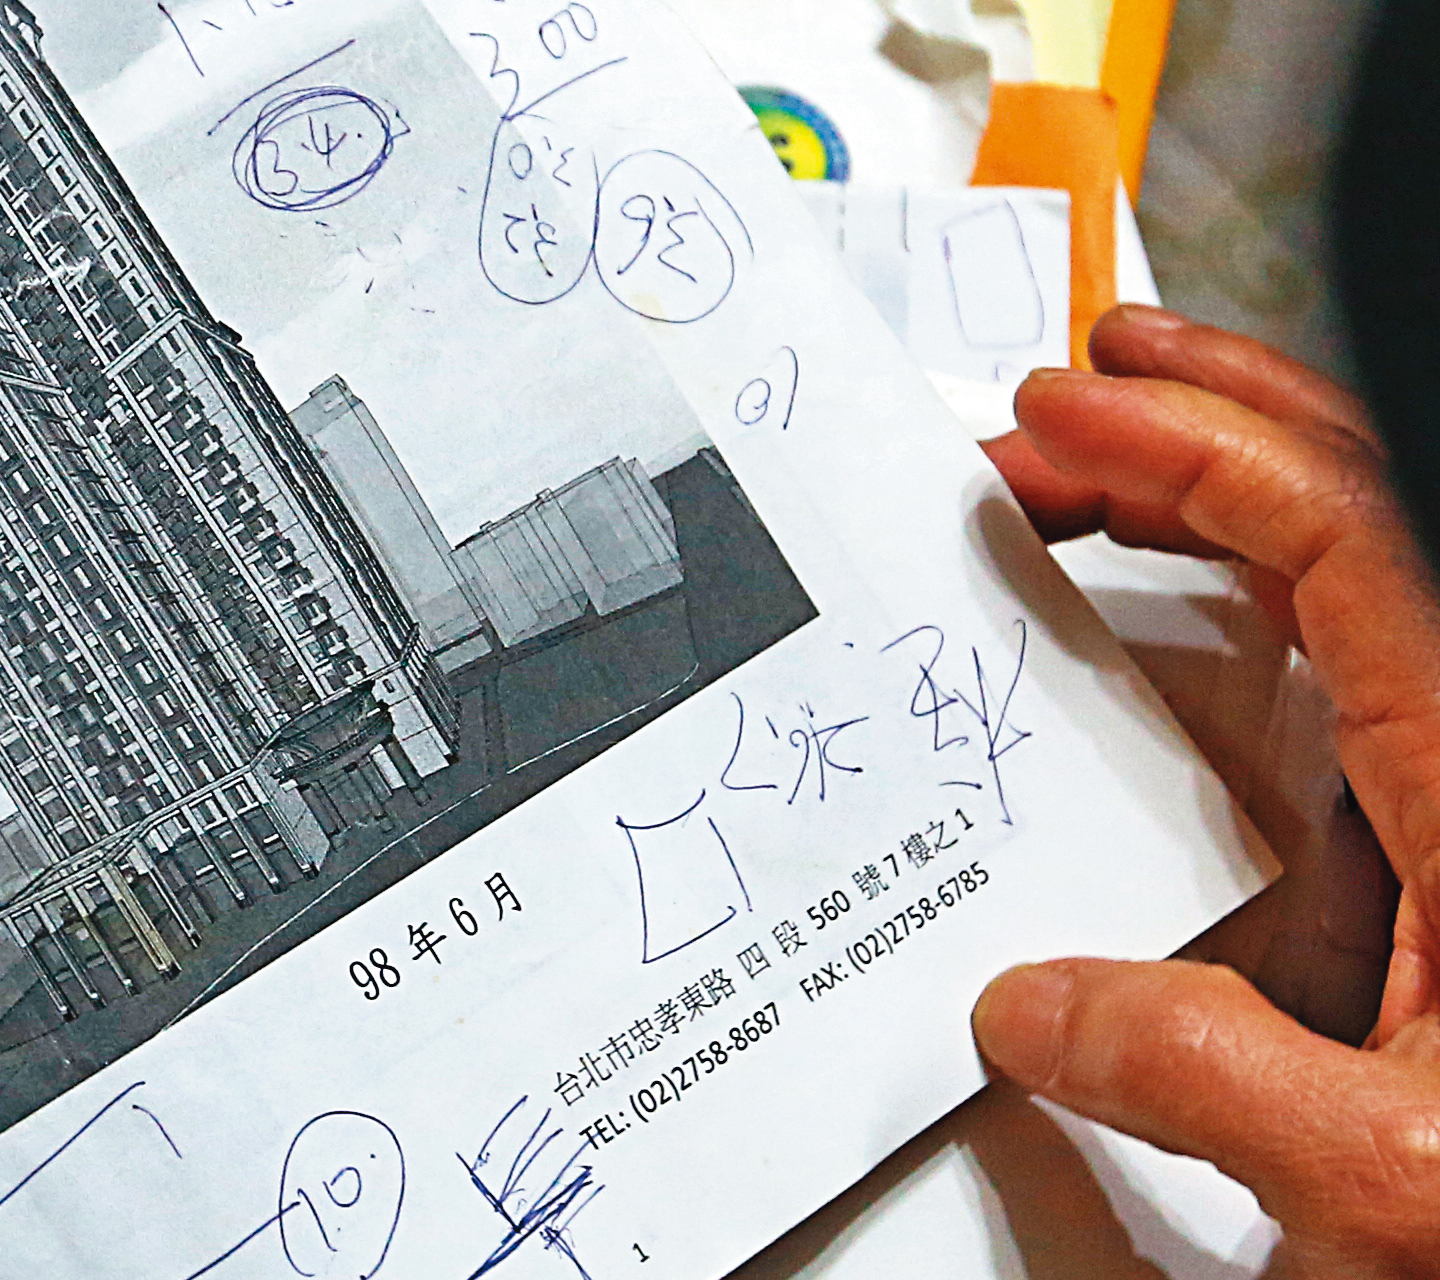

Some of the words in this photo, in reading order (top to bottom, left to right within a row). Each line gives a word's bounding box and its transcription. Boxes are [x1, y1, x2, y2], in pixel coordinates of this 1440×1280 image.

[578, 1108, 633, 1151] TEL:
[628, 1000, 782, 1124] (02)2758-8687
[799, 959, 850, 1003] FAX:
[845, 860, 990, 975] (02)2758-6785
